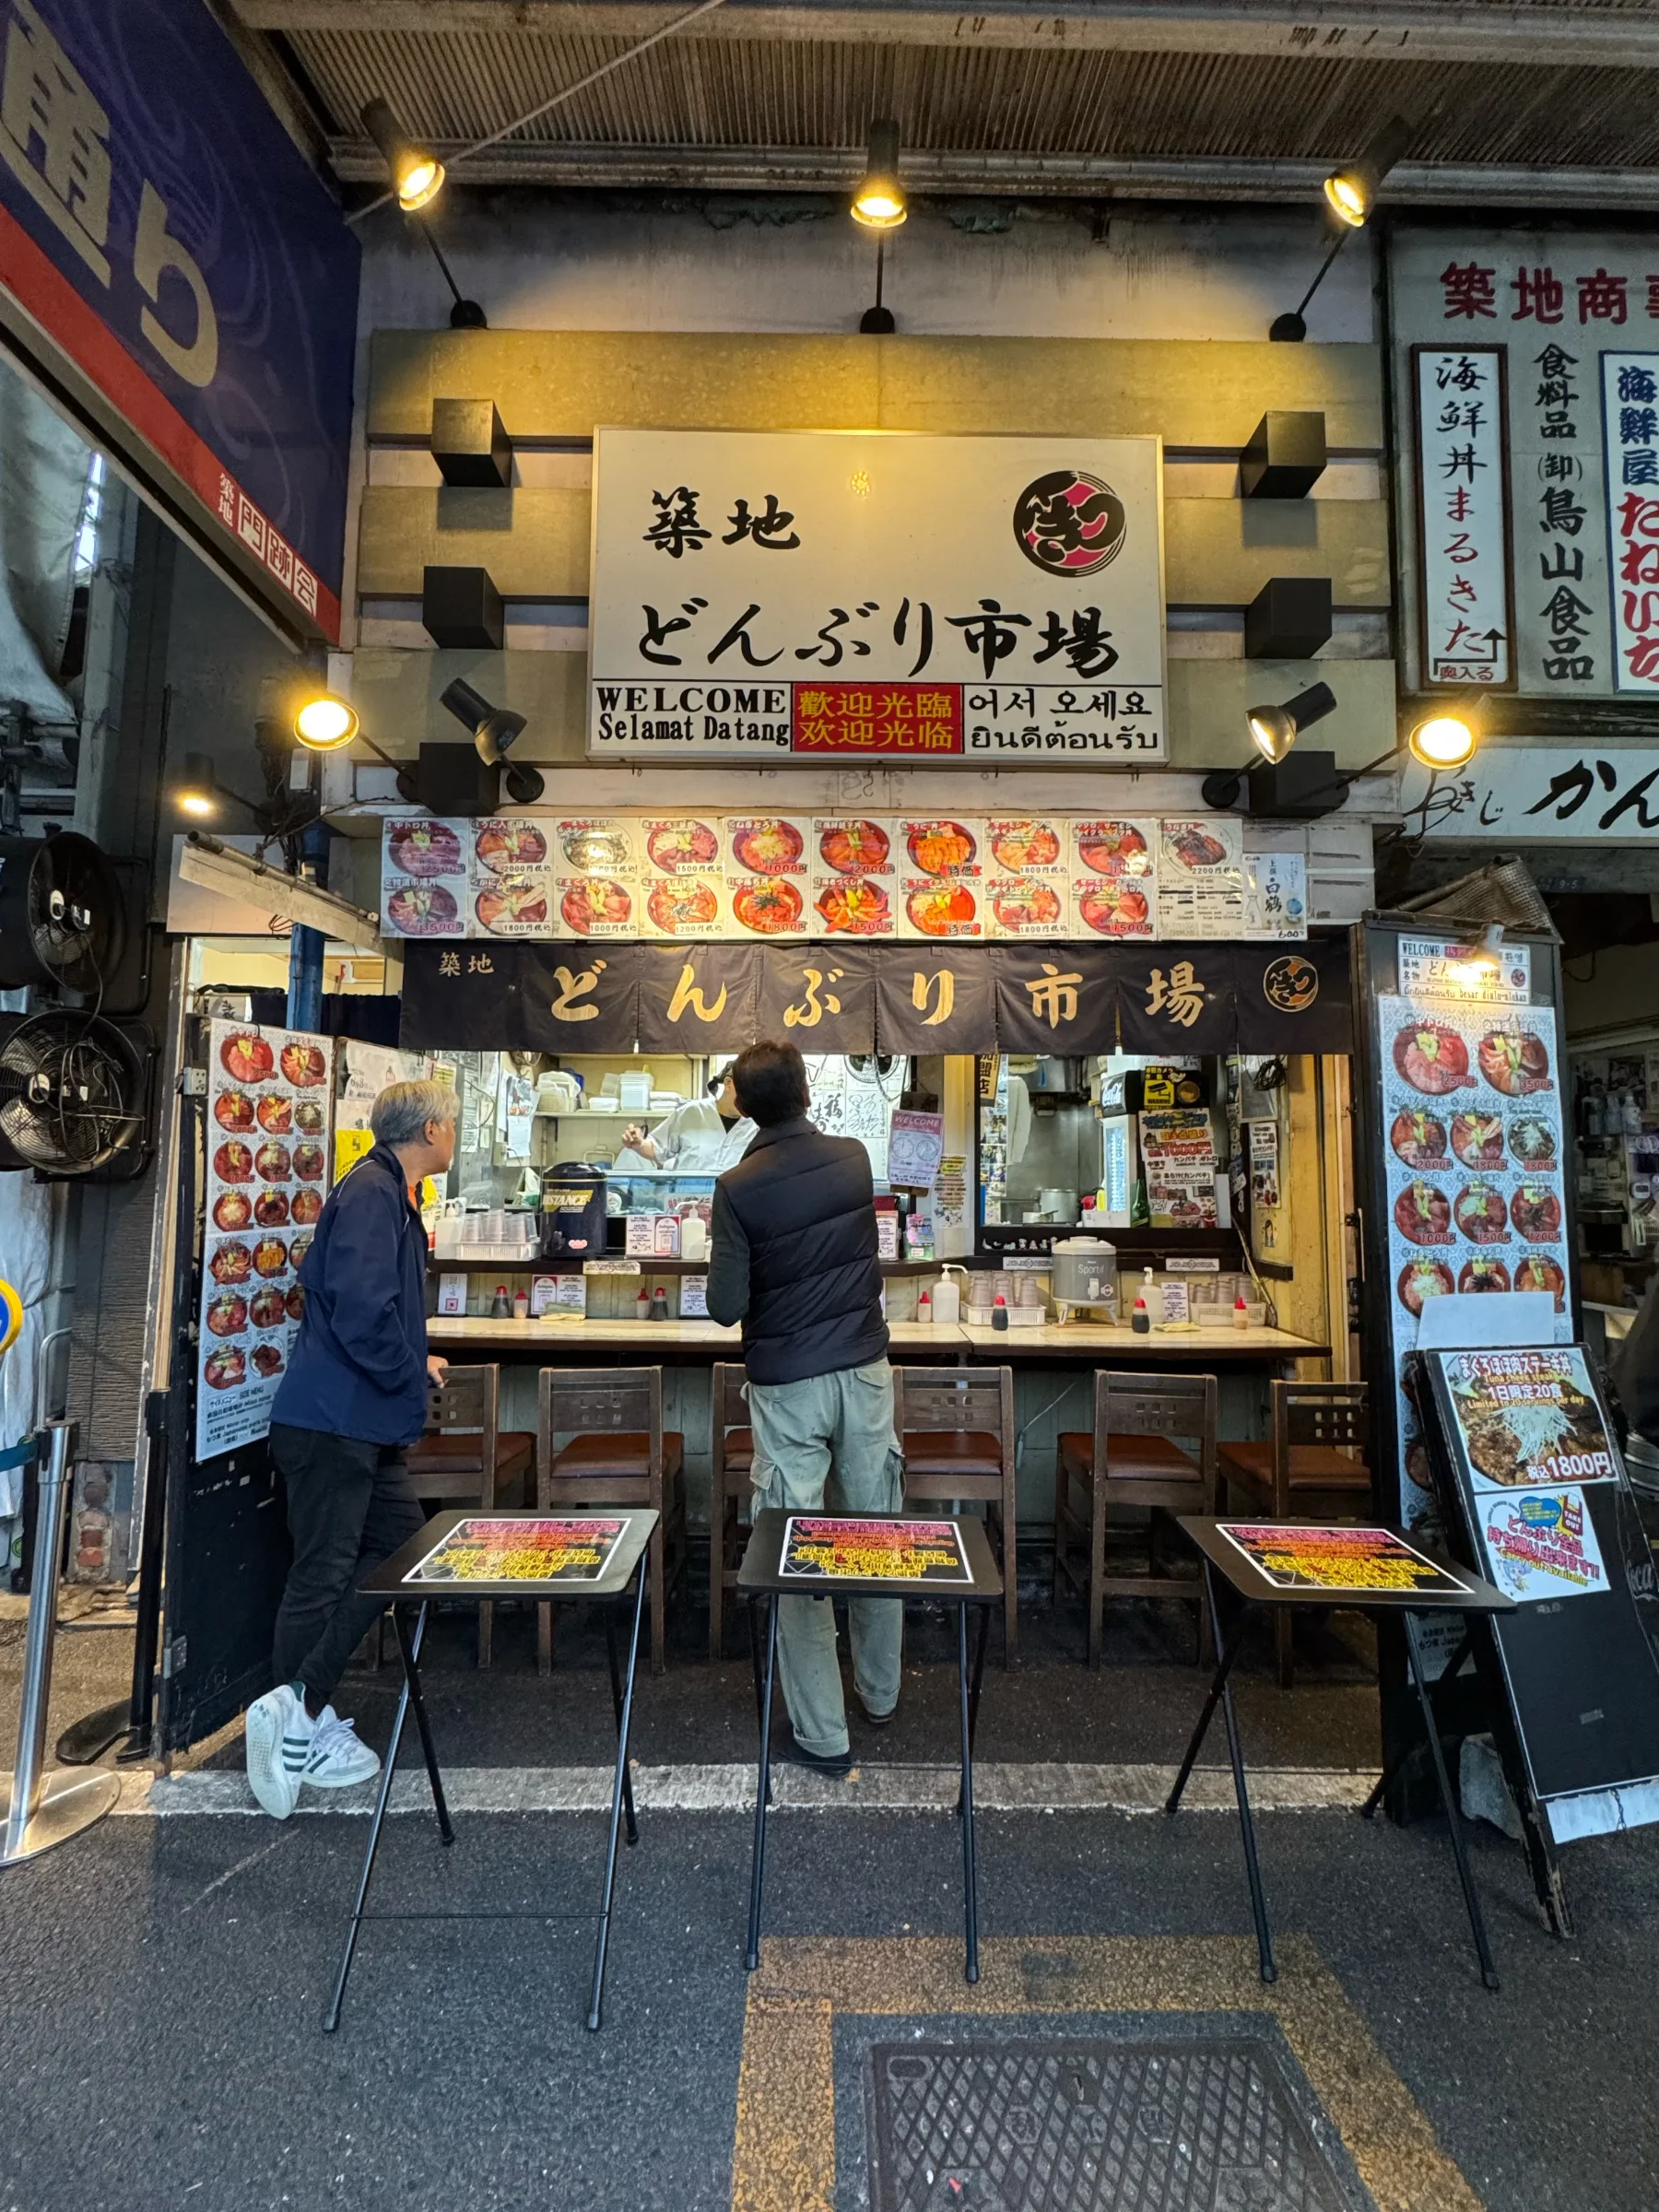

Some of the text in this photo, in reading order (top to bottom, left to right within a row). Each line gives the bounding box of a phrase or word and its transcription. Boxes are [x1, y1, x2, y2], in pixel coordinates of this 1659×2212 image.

[1440, 261, 1659, 324] 築地商
[1434, 355, 1488, 653] 海鮮丼まるきた
[642, 486, 802, 559] 築地
[238, 492, 318, 618] 門跡会
[642, 596, 1122, 680] どんぶり市場
[1439, 664, 1494, 681] 奥入る
[598, 687, 786, 713] WELCOME
[799, 689, 954, 719] 歡迎光臨
[970, 688, 1152, 722] 어서 오세요
[599, 712, 790, 747] Selamat Datang
[799, 720, 954, 749] 欢迎光临
[971, 720, 1159, 751] ยินดีต้อนรับ
[948, 865, 974, 876] 特価
[948, 924, 974, 935] 特価
[1402, 942, 1441, 957] WELCOME
[439, 952, 495, 978] 築地
[1403, 971, 1420, 981] 名物
[552, 959, 1206, 1030] どんぶり市場
[1459, 985, 1478, 999] besar
[894, 1113, 940, 1127] WELCOME
[1459, 1352, 1573, 1379] まぐろほほ肉ステーキ丼
[1484, 1371, 1554, 1383] Tuna cheek steak
[1467, 1399, 1499, 1409] Limited
[1500, 1398, 1510, 1407] to
[1511, 1397, 1522, 1406] 20
[1523, 1396, 1555, 1407] servings
[1570, 1395, 1584, 1406] day
[1488, 1382, 1563, 1400] 1日限定20食
[1526, 1452, 1613, 1479] 税込 1800円
[1564, 1511, 1582, 1524] TAKE
[1565, 1519, 1581, 1531] OUT
[1508, 1513, 1584, 1558] どんぶり全品
